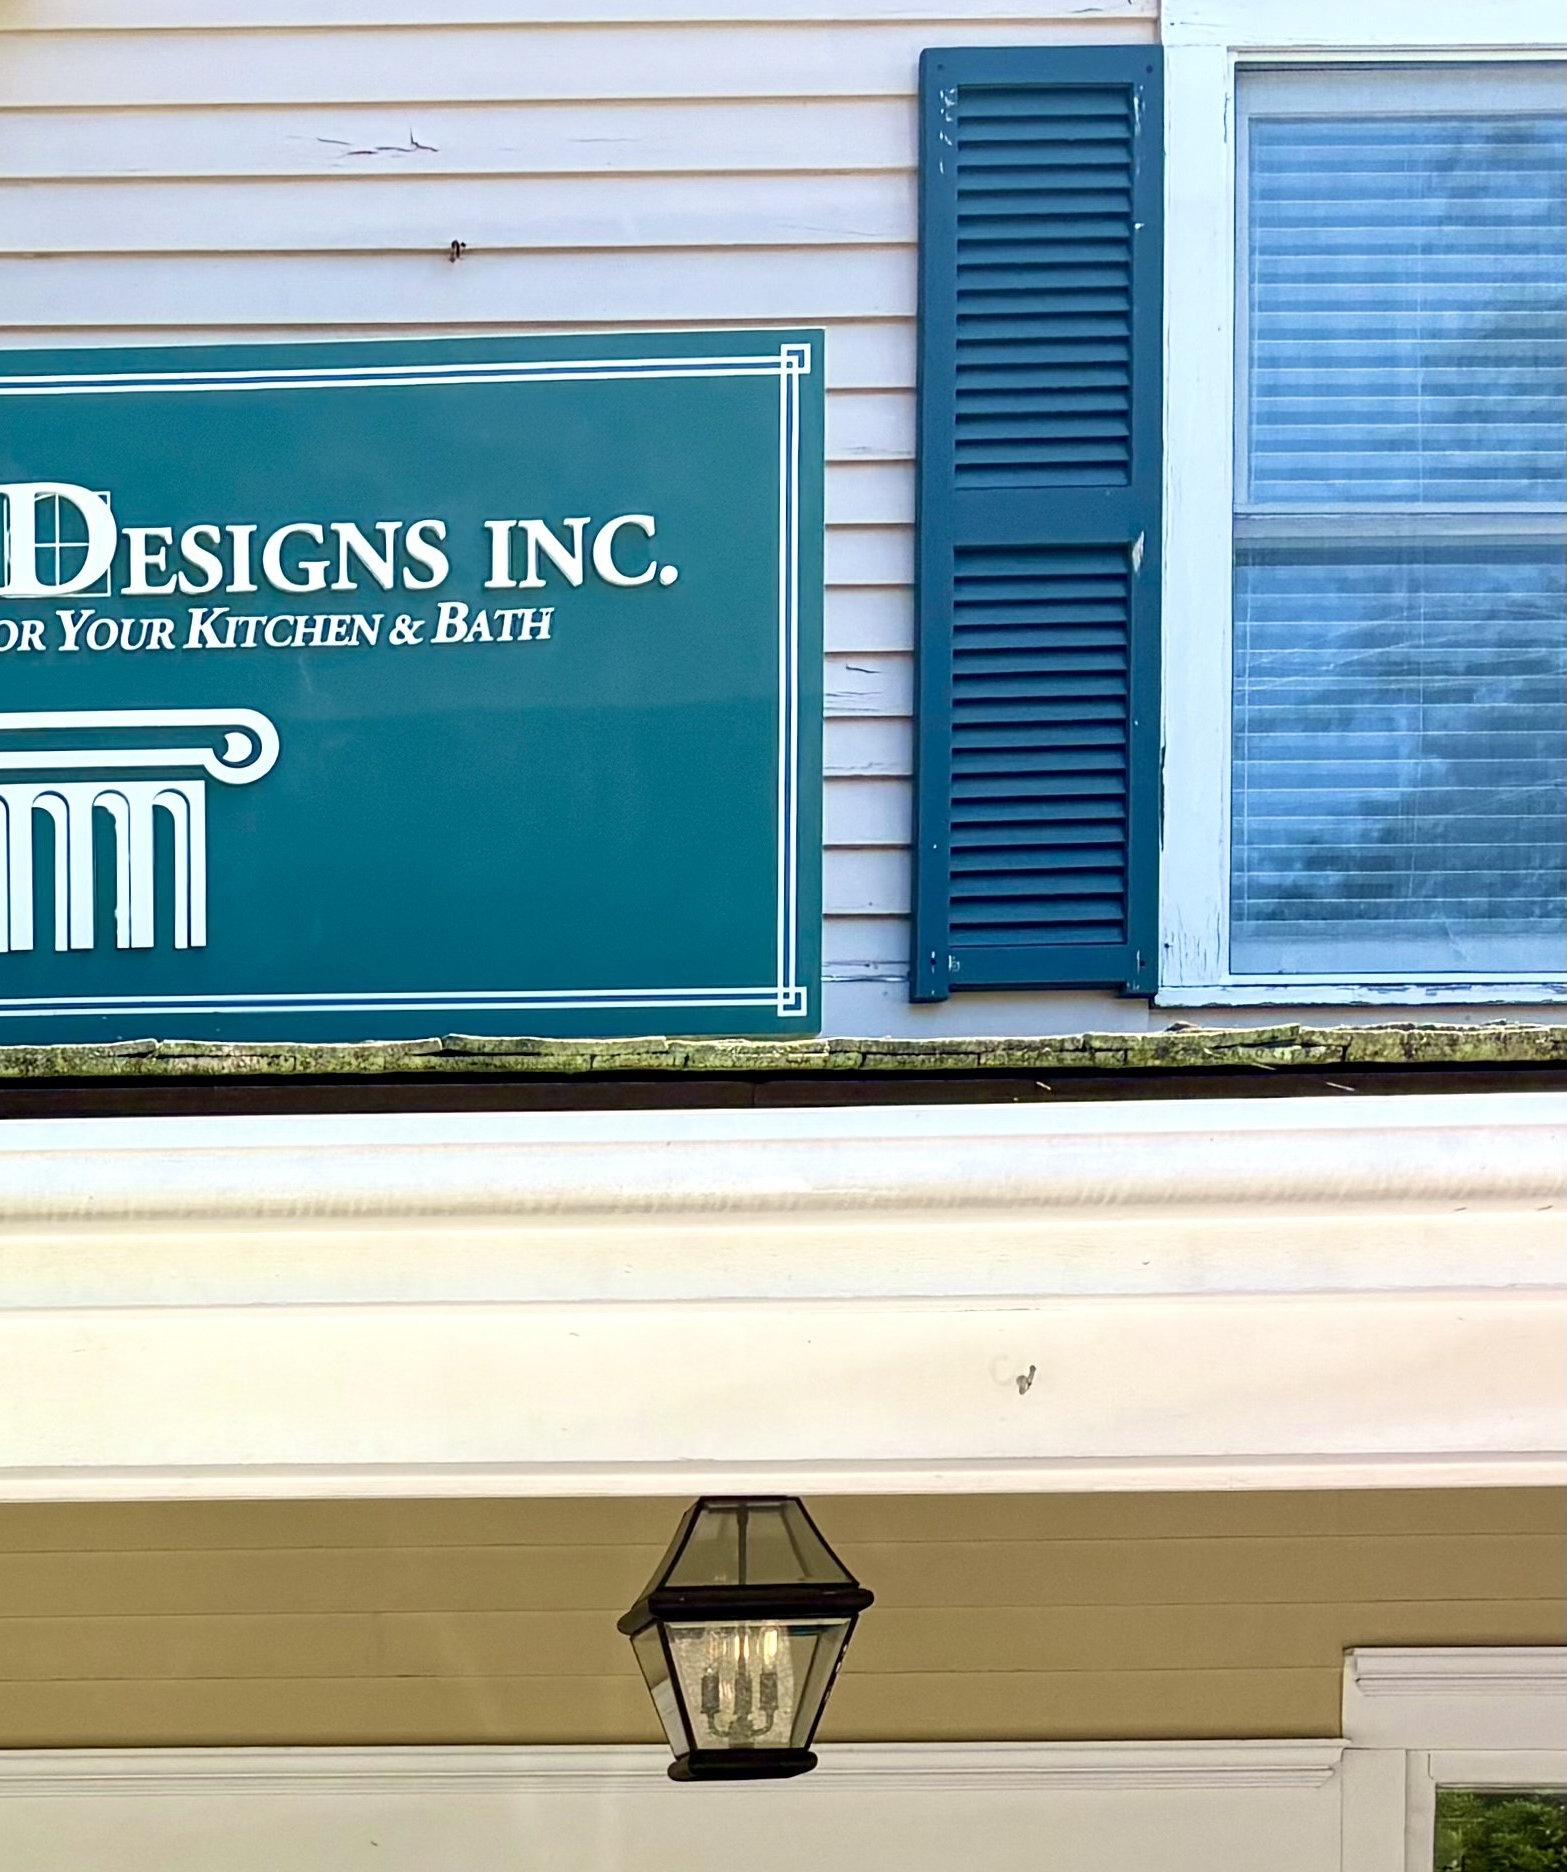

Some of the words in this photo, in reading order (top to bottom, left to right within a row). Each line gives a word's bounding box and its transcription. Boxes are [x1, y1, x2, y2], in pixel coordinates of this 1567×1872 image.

[483, 513, 680, 590] INC.
[57, 608, 175, 652] YOUR
[182, 607, 384, 650] KITCHEN
[388, 616, 425, 645] &
[431, 601, 556, 645] BATH
